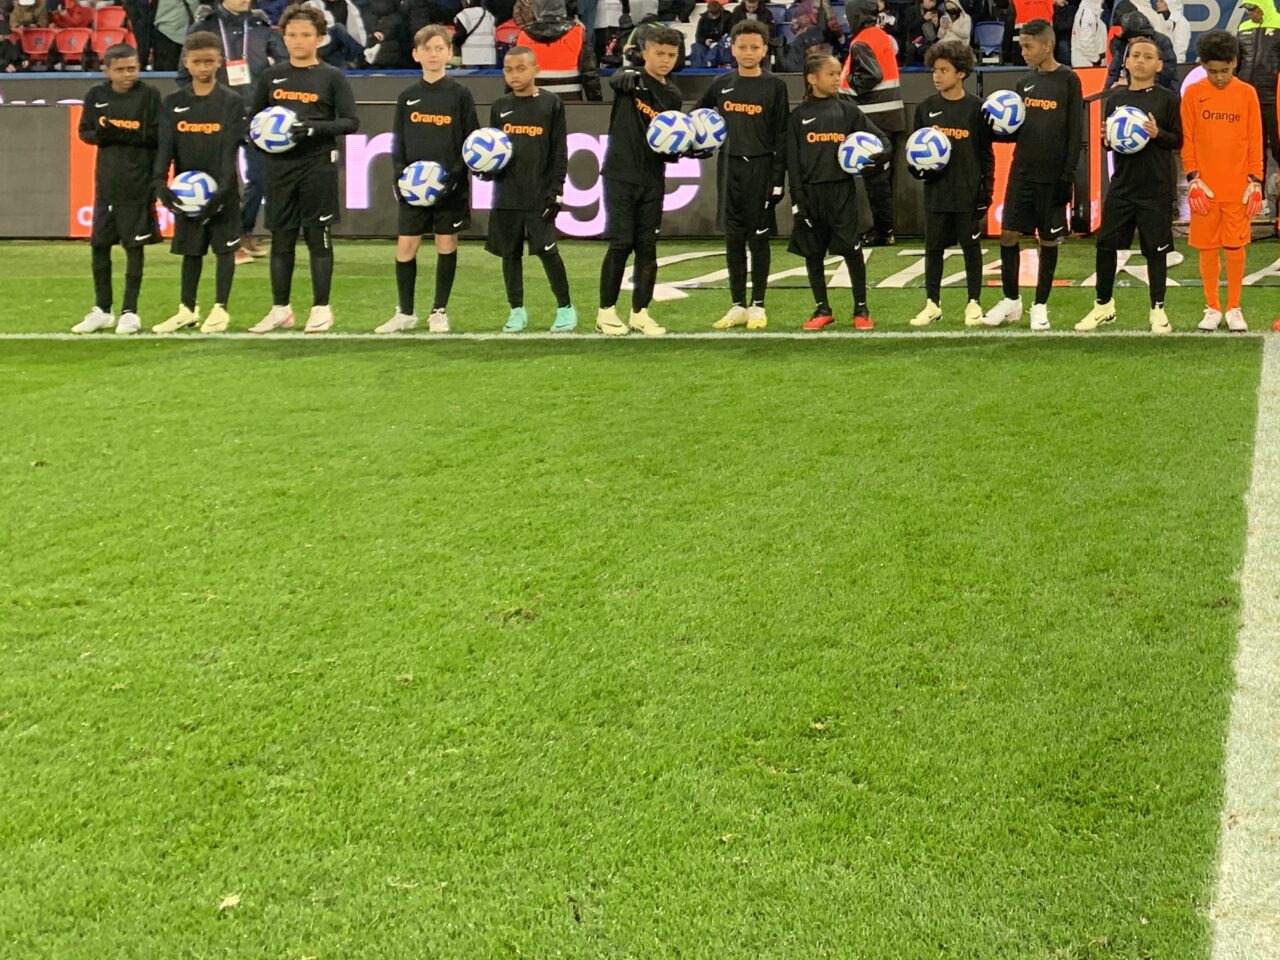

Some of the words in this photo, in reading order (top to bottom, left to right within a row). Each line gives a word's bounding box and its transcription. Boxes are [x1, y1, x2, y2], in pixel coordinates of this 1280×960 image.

[273, 89, 319, 103] Orange
[724, 101, 763, 115] Orange
[1024, 97, 1058, 110] Orange
[410, 112, 452, 126] Orange
[1202, 110, 1241, 123] Orange
[177, 121, 221, 134] Orange
[503, 123, 544, 137] Orange
[806, 132, 845, 143] Orange
